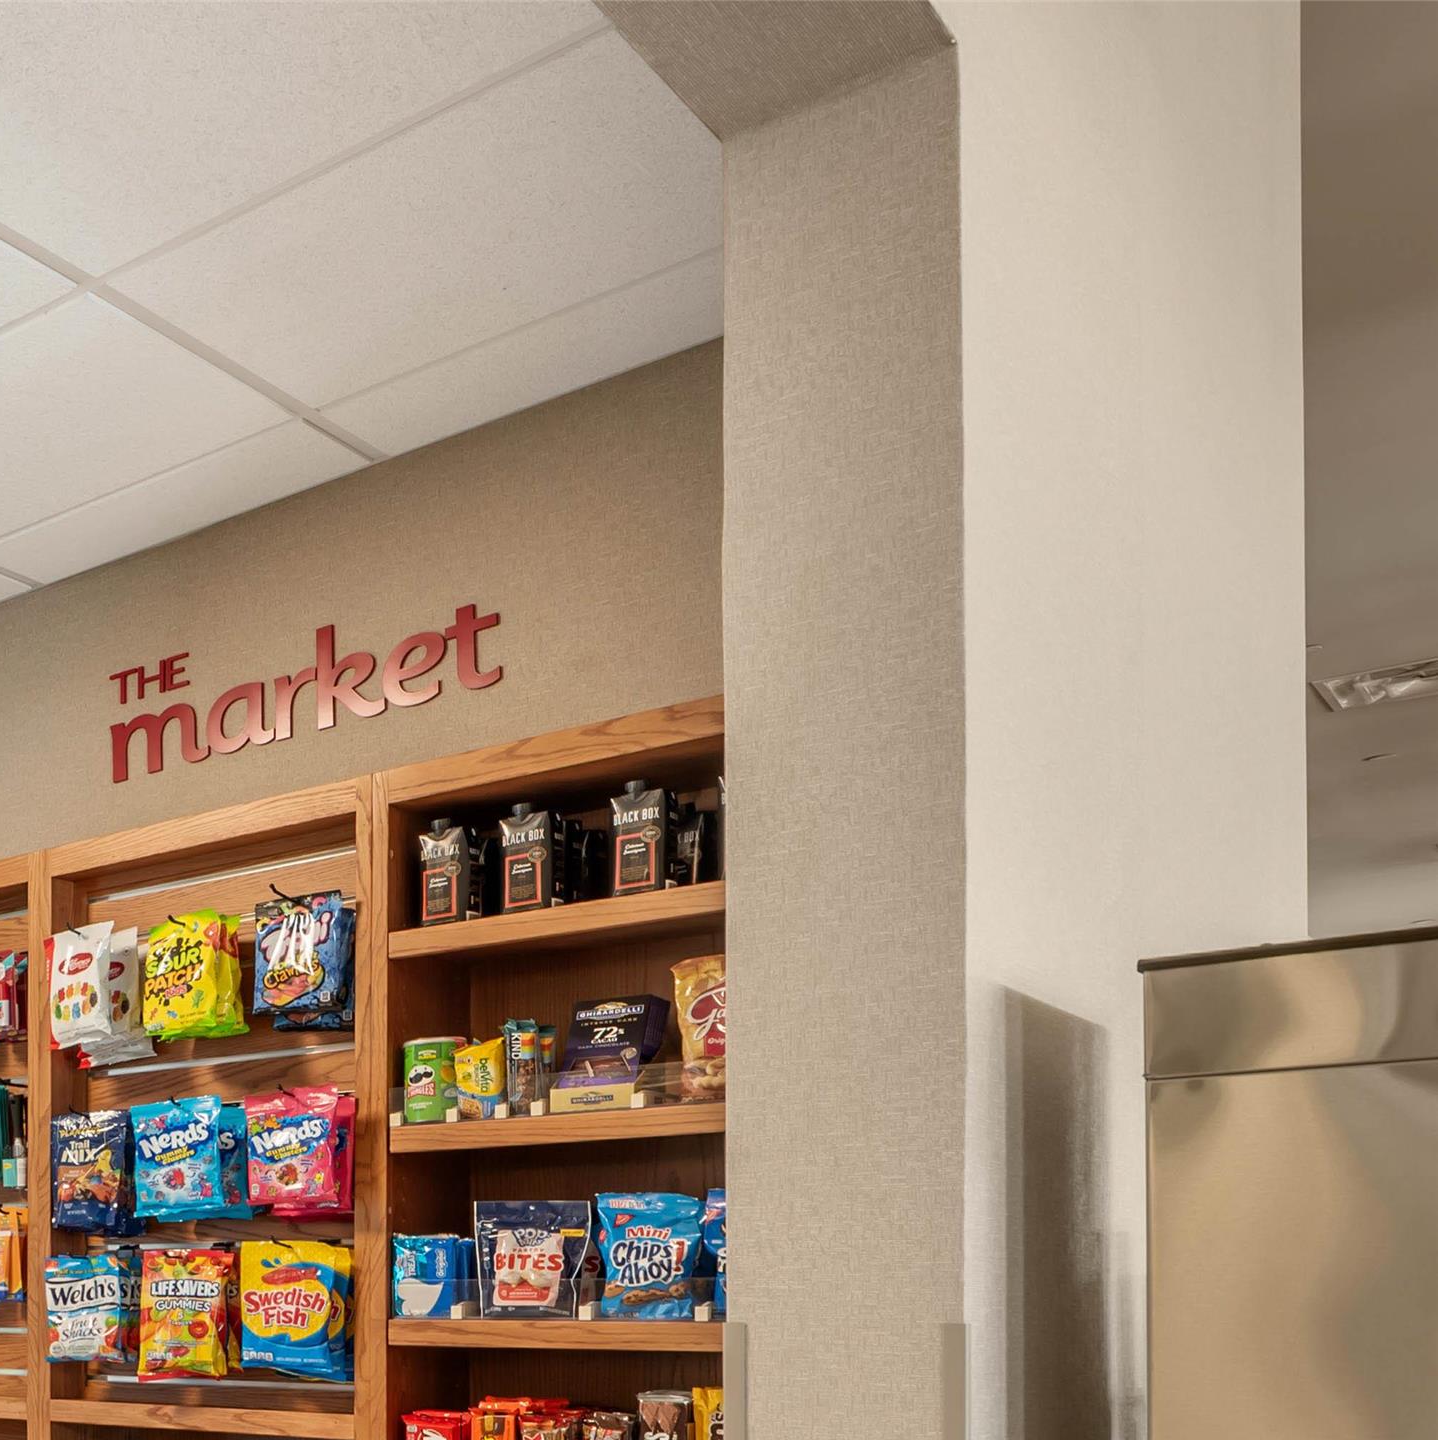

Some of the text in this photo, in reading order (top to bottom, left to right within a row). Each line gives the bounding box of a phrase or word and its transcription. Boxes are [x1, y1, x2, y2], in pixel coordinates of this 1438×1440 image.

[109, 651, 190, 704] THE
[110, 603, 503, 784] market
[613, 807, 660, 826] BLACK BOX
[502, 828, 545, 847] BLACK BOX
[146, 947, 201, 978] SOUR
[144, 963, 202, 999] PATCH
[579, 1006, 641, 1018] GHIRARDELLI
[511, 1032, 520, 1061] KIND
[626, 1225, 671, 1240] Mini
[494, 1253, 564, 1271] BITES
[612, 1241, 674, 1267] Chips
[49, 1279, 116, 1306] Welch's
[243, 1288, 327, 1314] Swedish
[156, 1300, 211, 1312] GUMMIES
[263, 1307, 309, 1329] Fish
